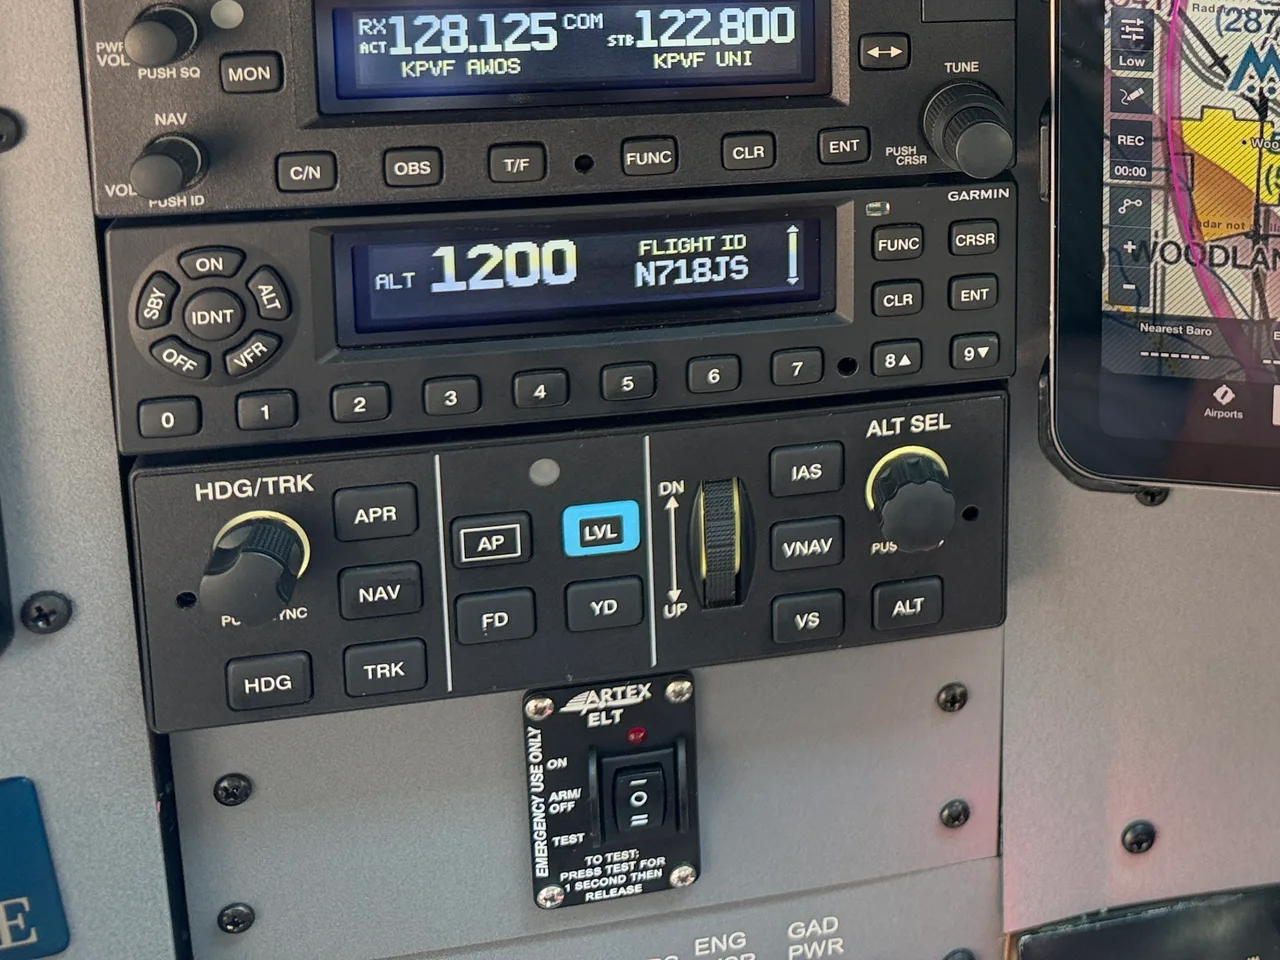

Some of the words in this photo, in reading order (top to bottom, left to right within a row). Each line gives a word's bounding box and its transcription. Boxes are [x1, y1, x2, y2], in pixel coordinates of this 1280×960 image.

[562, 13, 604, 31] COM
[634, 6, 796, 48] 122.800
[388, 11, 559, 56] 128.125
[401, 60, 456, 78] KPVF
[466, 58, 522, 76] AWOS
[653, 52, 705, 70] KPVF
[715, 50, 754, 68] UNI
[228, 66, 271, 82] MON
[829, 139, 860, 154] ENT
[1117, 135, 1144, 146] REC
[626, 150, 673, 166] FUNC
[732, 145, 765, 161] CLR
[394, 160, 431, 176] OBS
[947, 188, 1010, 202] GARMIN
[878, 237, 920, 253] FUNC
[955, 232, 996, 247] CRSR
[195, 257, 224, 272] ON
[430, 240, 577, 291] 1200
[634, 256, 749, 288] N718JS
[883, 292, 913, 308] CLR
[960, 287, 990, 302] ENT
[192, 310, 235, 326] IDNT
[1140, 323, 1181, 336] Nearest
[1184, 325, 1212, 337] Baro
[1204, 407, 1243, 421] Airports
[865, 418, 906, 438] ALT
[909, 413, 951, 433] SEL
[194, 474, 314, 502] HDG/TRK
[354, 506, 397, 525] APR
[782, 538, 833, 557] VNAV
[358, 584, 401, 603] NAV
[891, 597, 925, 616] ALT
[363, 661, 405, 680] TRK
[244, 674, 292, 694] HDG
[586, 682, 652, 704] ARTEX
[587, 709, 624, 728] ELT
[527, 726, 543, 763] ONLY
[546, 757, 568, 770] ON
[530, 764, 545, 792] USE
[547, 789, 582, 803] ARM/
[549, 800, 575, 814] OFF
[531, 794, 549, 878] EMERGENCY
[552, 832, 585, 847] TEST
[560, 867, 602, 882] PRESS
[604, 861, 636, 875] TEST
[639, 856, 666, 869] FOR
[585, 855, 602, 866] TO
[574, 877, 626, 891] SECOND
[630, 869, 662, 882] THEN
[585, 884, 643, 902] RELEASE
[787, 917, 839, 937] GAD
[694, 932, 747, 955] ENG
